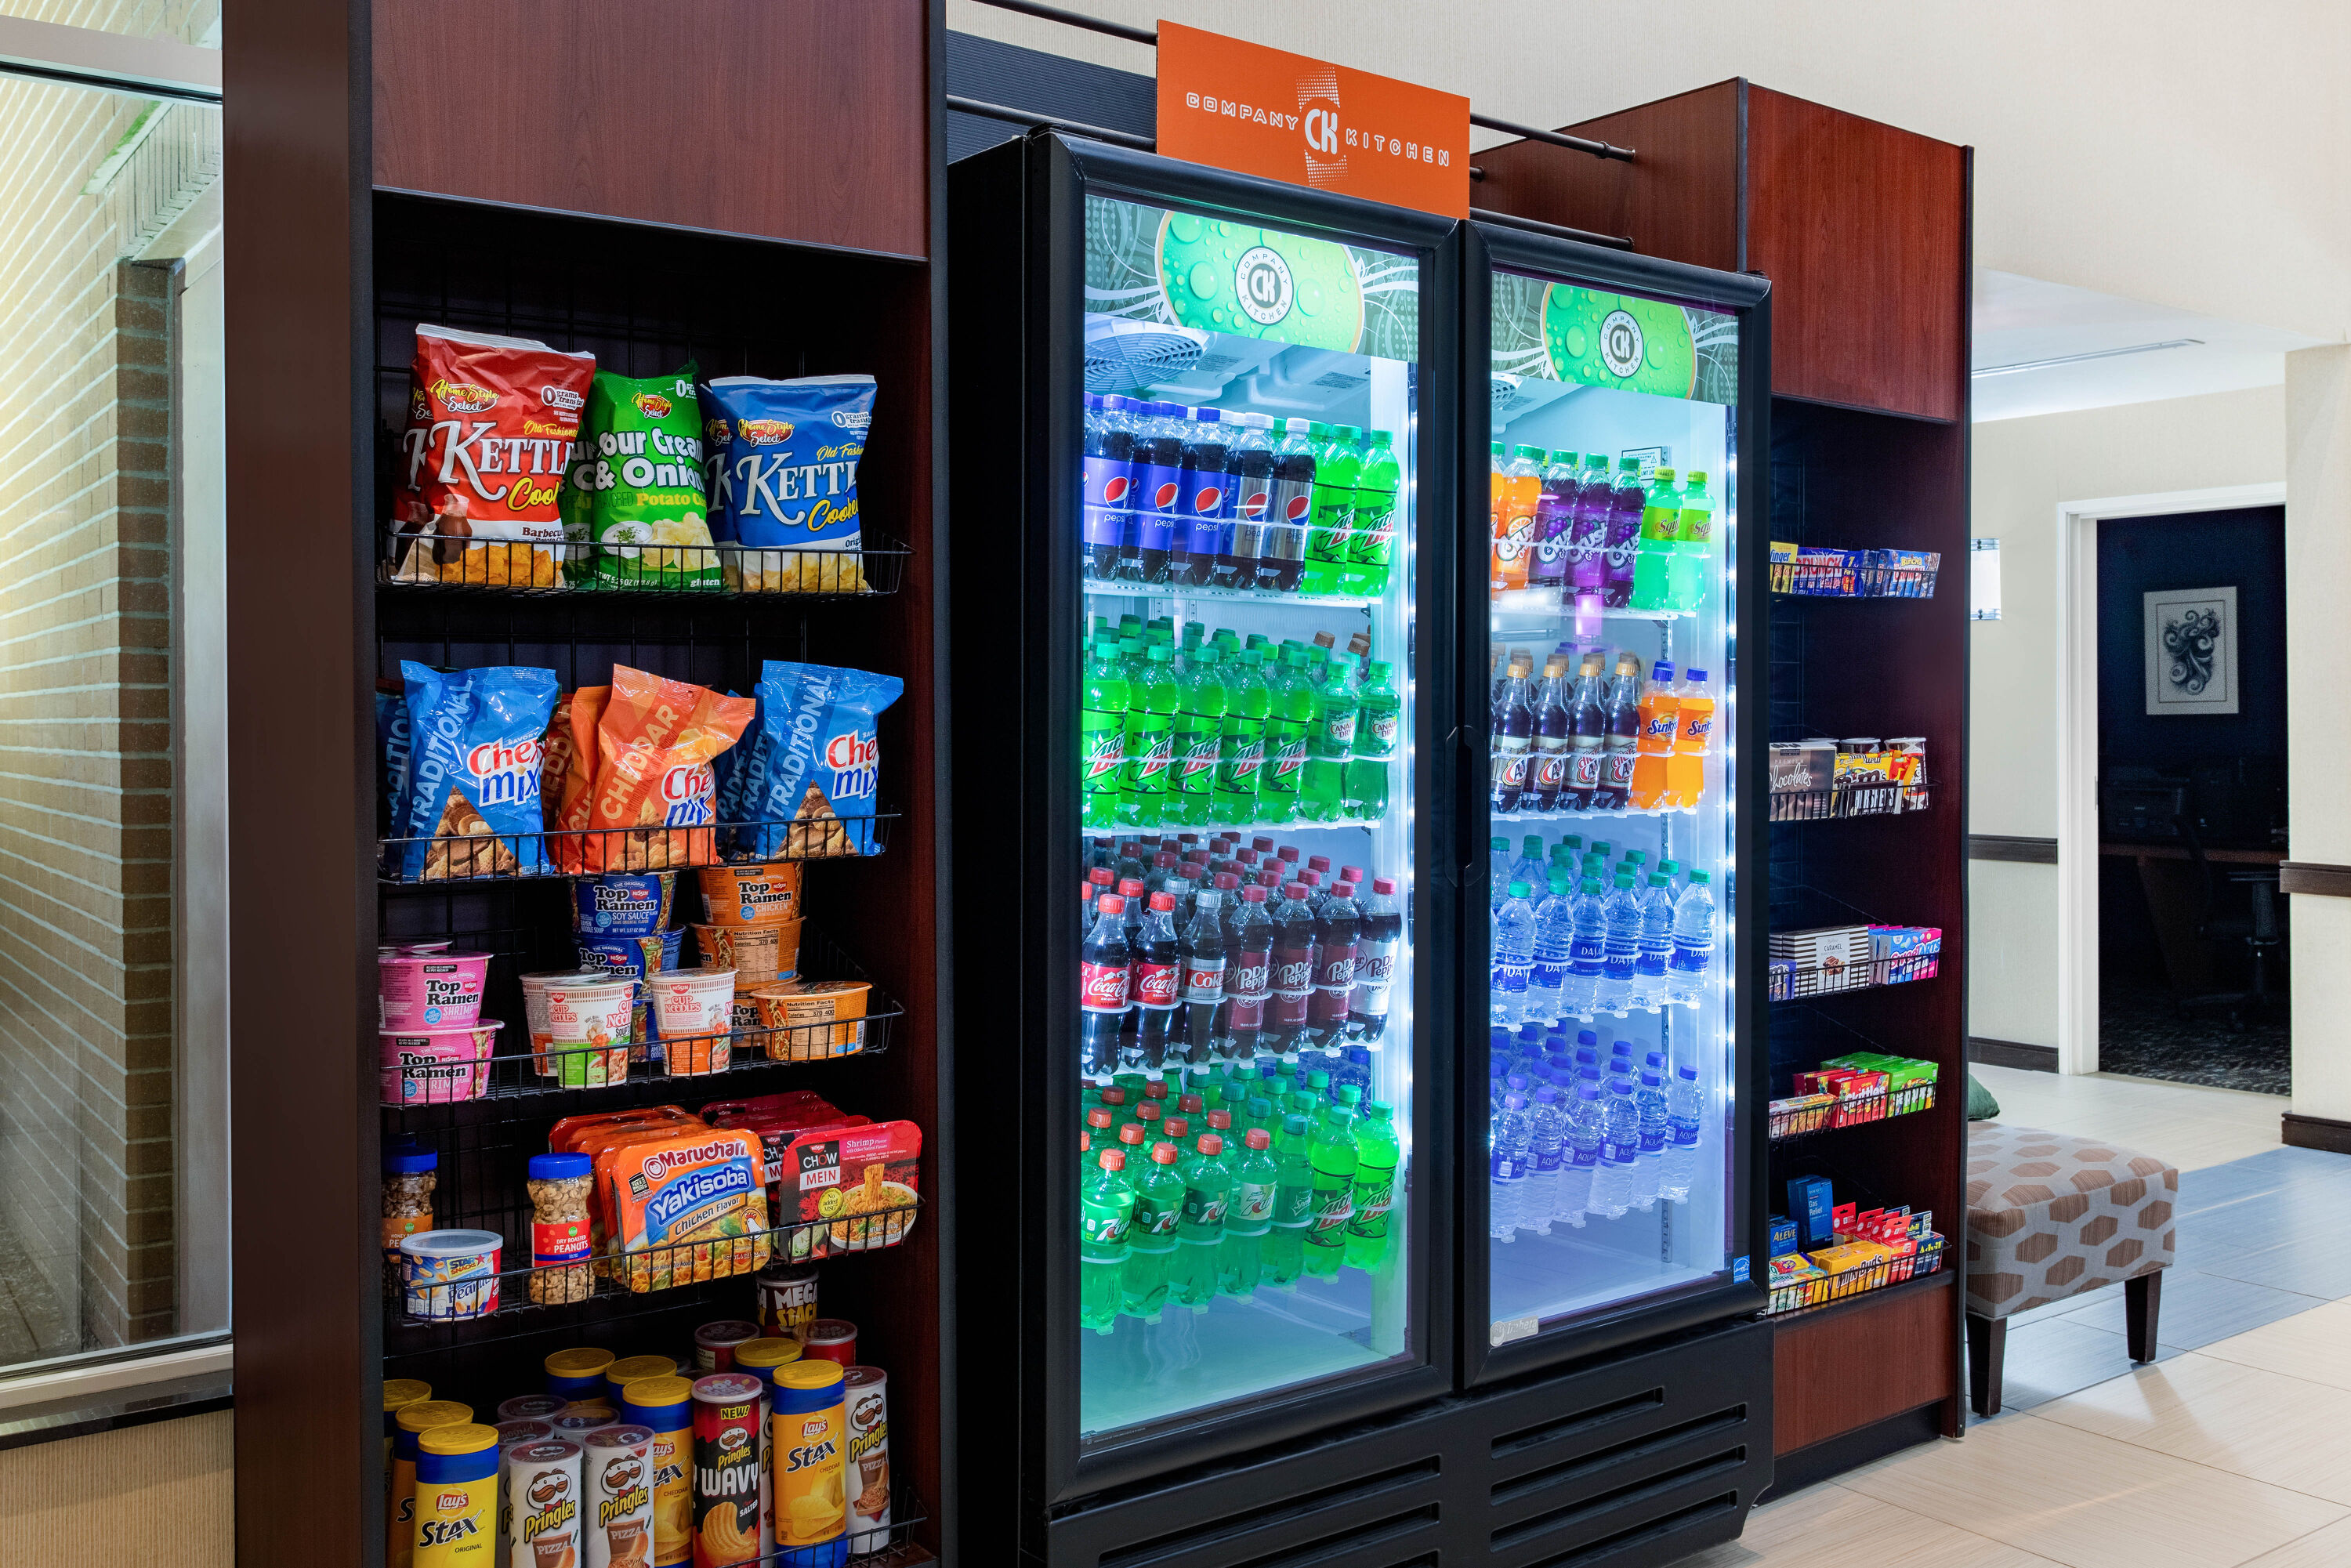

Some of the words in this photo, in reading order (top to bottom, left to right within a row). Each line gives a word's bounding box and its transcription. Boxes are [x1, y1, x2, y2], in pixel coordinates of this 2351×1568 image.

[1186, 92, 1299, 130] COMPANY
[1305, 109, 1338, 154] CK
[1346, 128, 1449, 167] KITCHEN
[1251, 269, 1275, 302] CK
[1612, 329, 1630, 358] CK
[430, 378, 467, 400] Home
[467, 384, 500, 402] Style
[447, 396, 483, 412] Select
[632, 393, 655, 409] Home
[655, 396, 672, 409] Style
[644, 405, 663, 418] Select
[524, 420, 543, 435] Old
[738, 418, 766, 437] Home
[767, 420, 795, 435] Style
[651, 427, 702, 463] Cream
[751, 432, 781, 447] Select
[817, 445, 838, 461] Old
[596, 460, 617, 490] &
[622, 456, 705, 492] Onion
[736, 452, 857, 525] KETTL
[636, 493, 690, 506] Potato
[1196, 523, 1219, 532] pepsi
[1795, 557, 1842, 575] CRUNCH
[766, 674, 833, 817] TRADITIONAL
[408, 682, 472, 830] TRADITIONAL
[600, 704, 679, 820] CHEDDAR
[483, 765, 538, 803] mix
[594, 886, 629, 901] Top
[737, 881, 770, 895] Top
[596, 900, 657, 911] Ramen
[740, 891, 792, 905] Ramen
[755, 903, 788, 912] CHICKEN
[628, 911, 649, 920] SAUCE
[579, 948, 607, 965] Top
[425, 979, 462, 994] Top
[426, 992, 480, 1006] Ramen
[671, 996, 693, 1005] CUP
[444, 1005, 473, 1016] SHRIMP
[552, 1005, 569, 1013] CUP
[665, 1002, 701, 1013] NOODLES
[401, 1066, 468, 1079] Ramen
[847, 1139, 874, 1148] Shrimp
[659, 1141, 746, 1167] Maruchan
[803, 1153, 838, 1168] CHOW
[806, 1169, 836, 1185] MEIN
[653, 1168, 748, 1220] Yakisoba
[675, 1208, 714, 1236] Chicken
[716, 1197, 740, 1212] Flavor
[1809, 1207, 1823, 1215] Relief
[1773, 1229, 1796, 1242] ALEVE
[554, 1240, 588, 1253] PEANUTS
[450, 1258, 475, 1269] STAR
[451, 1262, 476, 1274] SNACKS
[721, 1405, 750, 1420] NEW!
[718, 1446, 751, 1472] Pringles
[819, 1462, 841, 1473] CHEDDAR
[701, 1462, 759, 1497] WAVY
[664, 1487, 688, 1497] CHEDDAR
[600, 1486, 648, 1528] Pringles
[524, 1500, 576, 1544] Pringles
[610, 1526, 641, 1540] PIZZA
[455, 1544, 483, 1553] ORIGINAL
[537, 1541, 568, 1555] PIZZA
